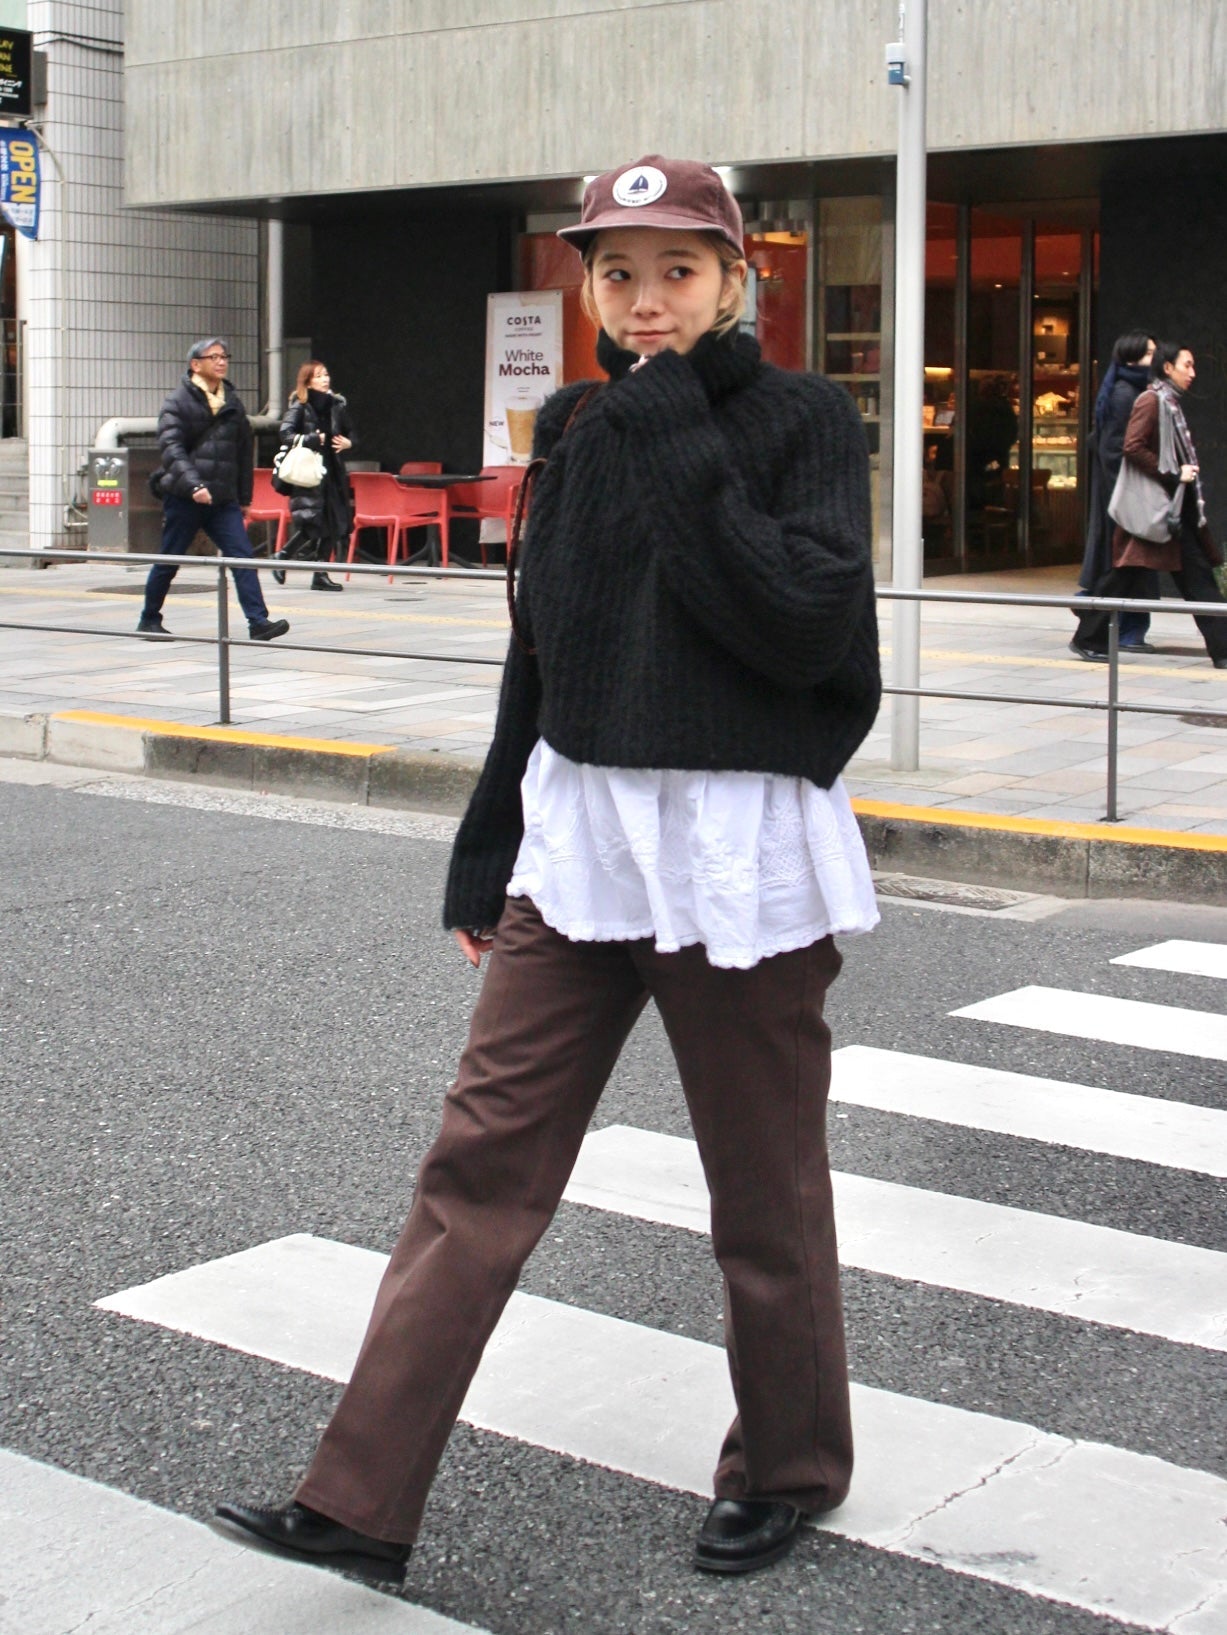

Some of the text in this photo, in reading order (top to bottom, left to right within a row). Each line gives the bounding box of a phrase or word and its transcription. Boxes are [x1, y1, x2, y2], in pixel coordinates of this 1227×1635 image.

[9, 141, 36, 203] OPEN
[507, 315, 541, 326] COSTA
[505, 350, 544, 362] White
[499, 362, 550, 376] Mocha
